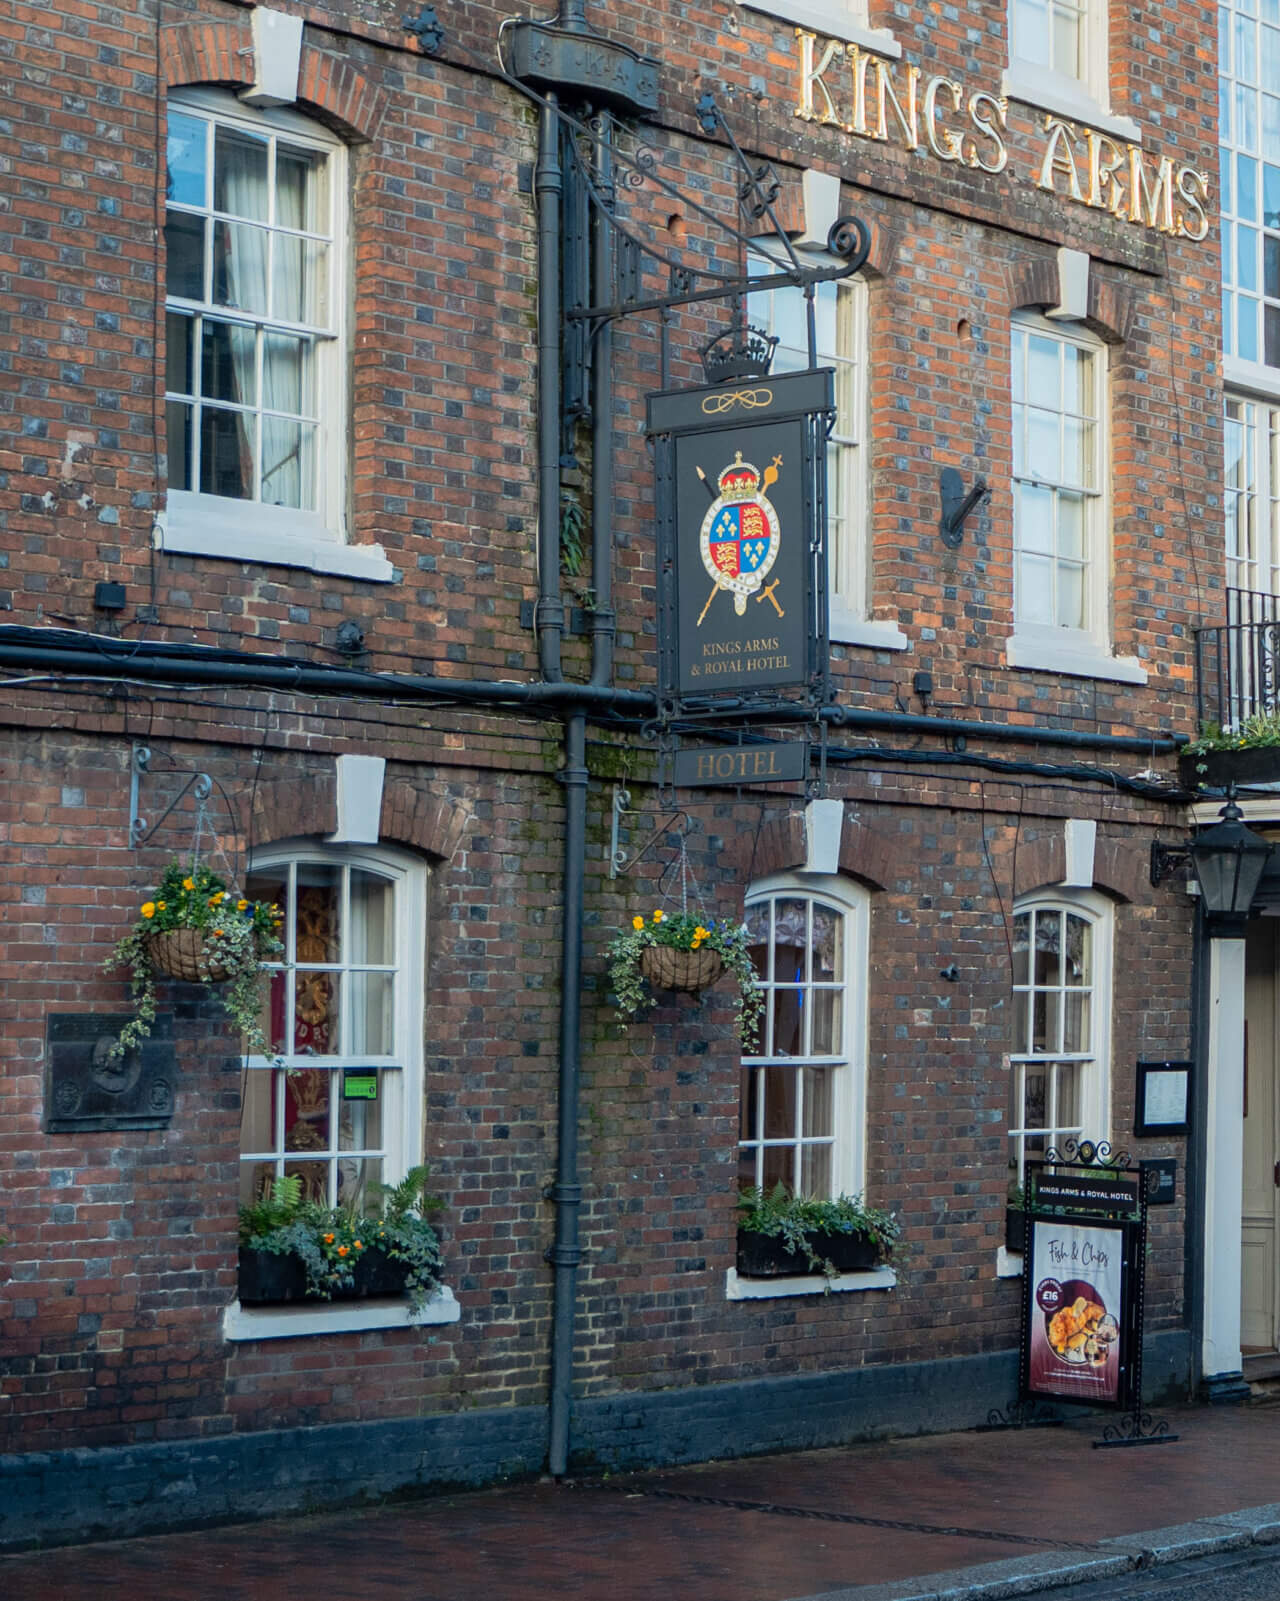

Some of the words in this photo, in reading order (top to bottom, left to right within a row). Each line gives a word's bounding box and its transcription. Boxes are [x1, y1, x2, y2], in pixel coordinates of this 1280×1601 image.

[793, 28, 1009, 174] KINGS
[1035, 115, 1210, 242] ARMS
[702, 641, 741, 656] KINGS
[744, 637, 780, 652] ARMS
[690, 663, 701, 677] &
[704, 660, 744, 675] ROYAL
[747, 655, 791, 671] HOTEL
[696, 751, 782, 779] HOTEL
[1040, 1186, 1060, 1195] KINGS
[1061, 1188, 1080, 1196] ARMS
[1087, 1190, 1109, 1199] ROYAL
[1110, 1193, 1134, 1201] HOTEL
[1047, 1239, 1070, 1263] Fish
[1071, 1241, 1079, 1260] &
[1081, 1241, 1110, 1268] Chips
[1042, 1291, 1059, 1301] £16
